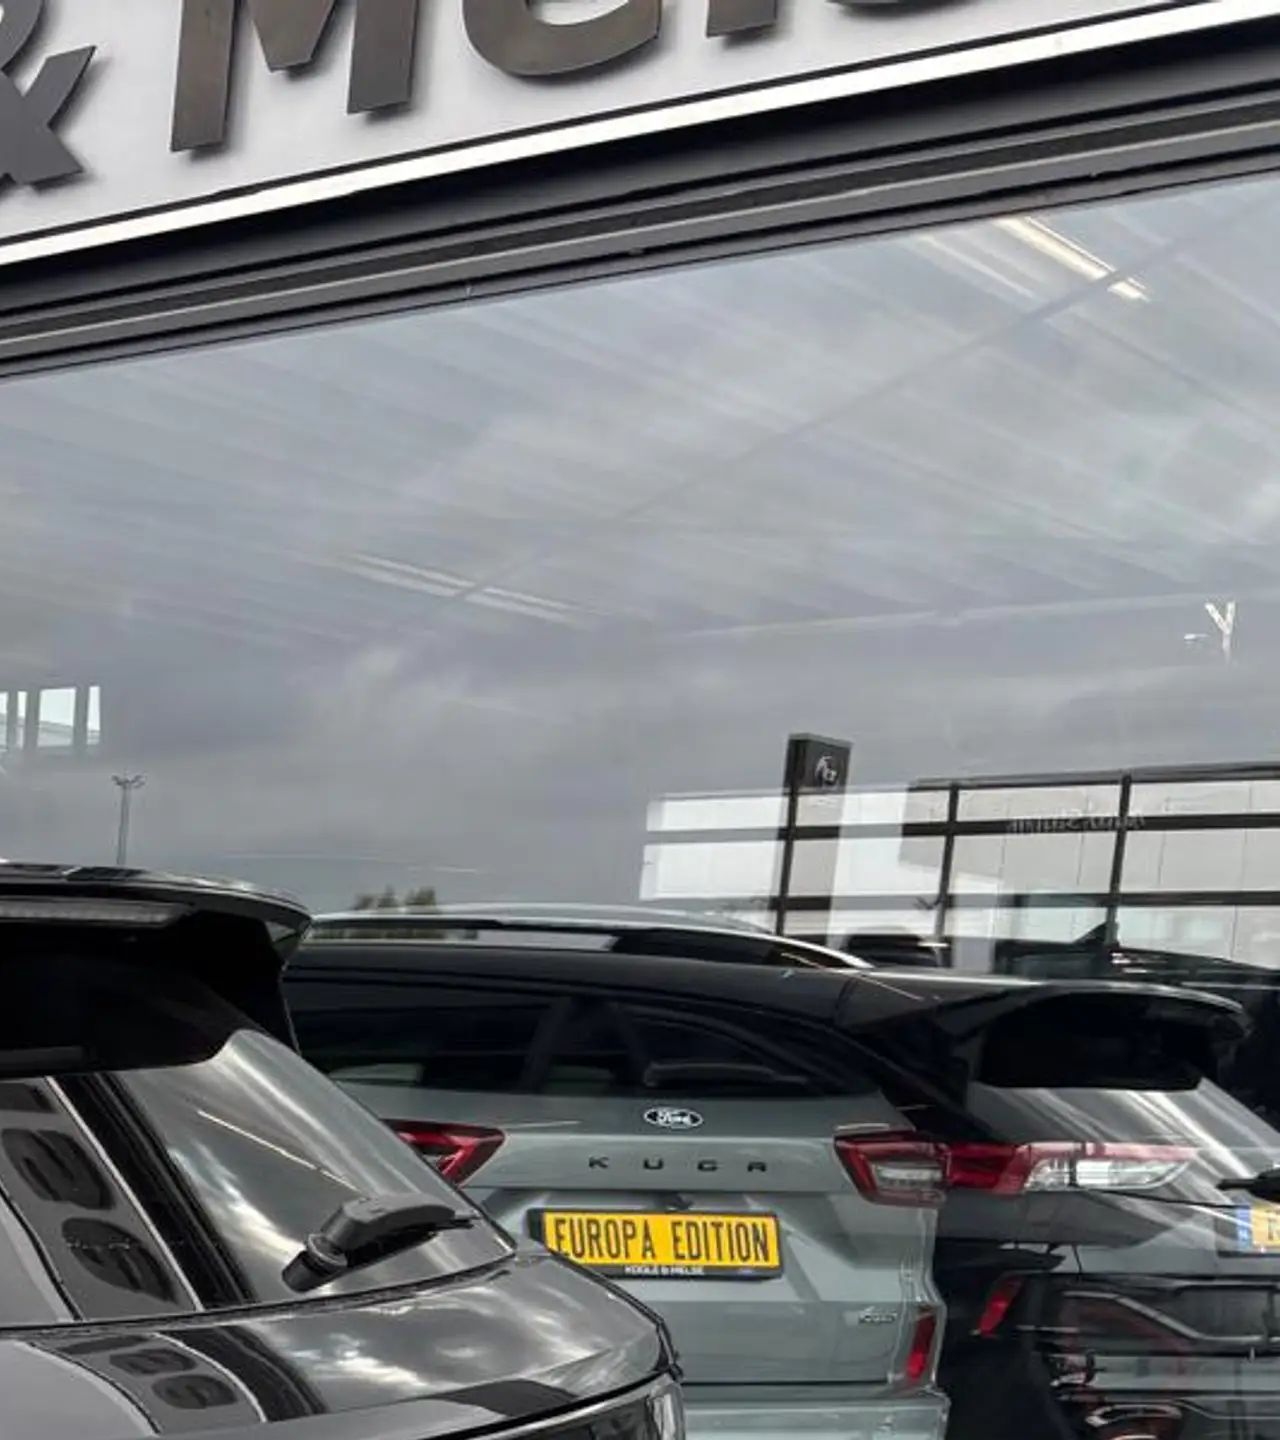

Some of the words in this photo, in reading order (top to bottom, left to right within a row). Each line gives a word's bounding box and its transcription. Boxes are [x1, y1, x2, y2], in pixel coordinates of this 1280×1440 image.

[588, 1156, 768, 1173] KUGA
[553, 1216, 657, 1260] EUROPA
[670, 1220, 771, 1263] EDITION
